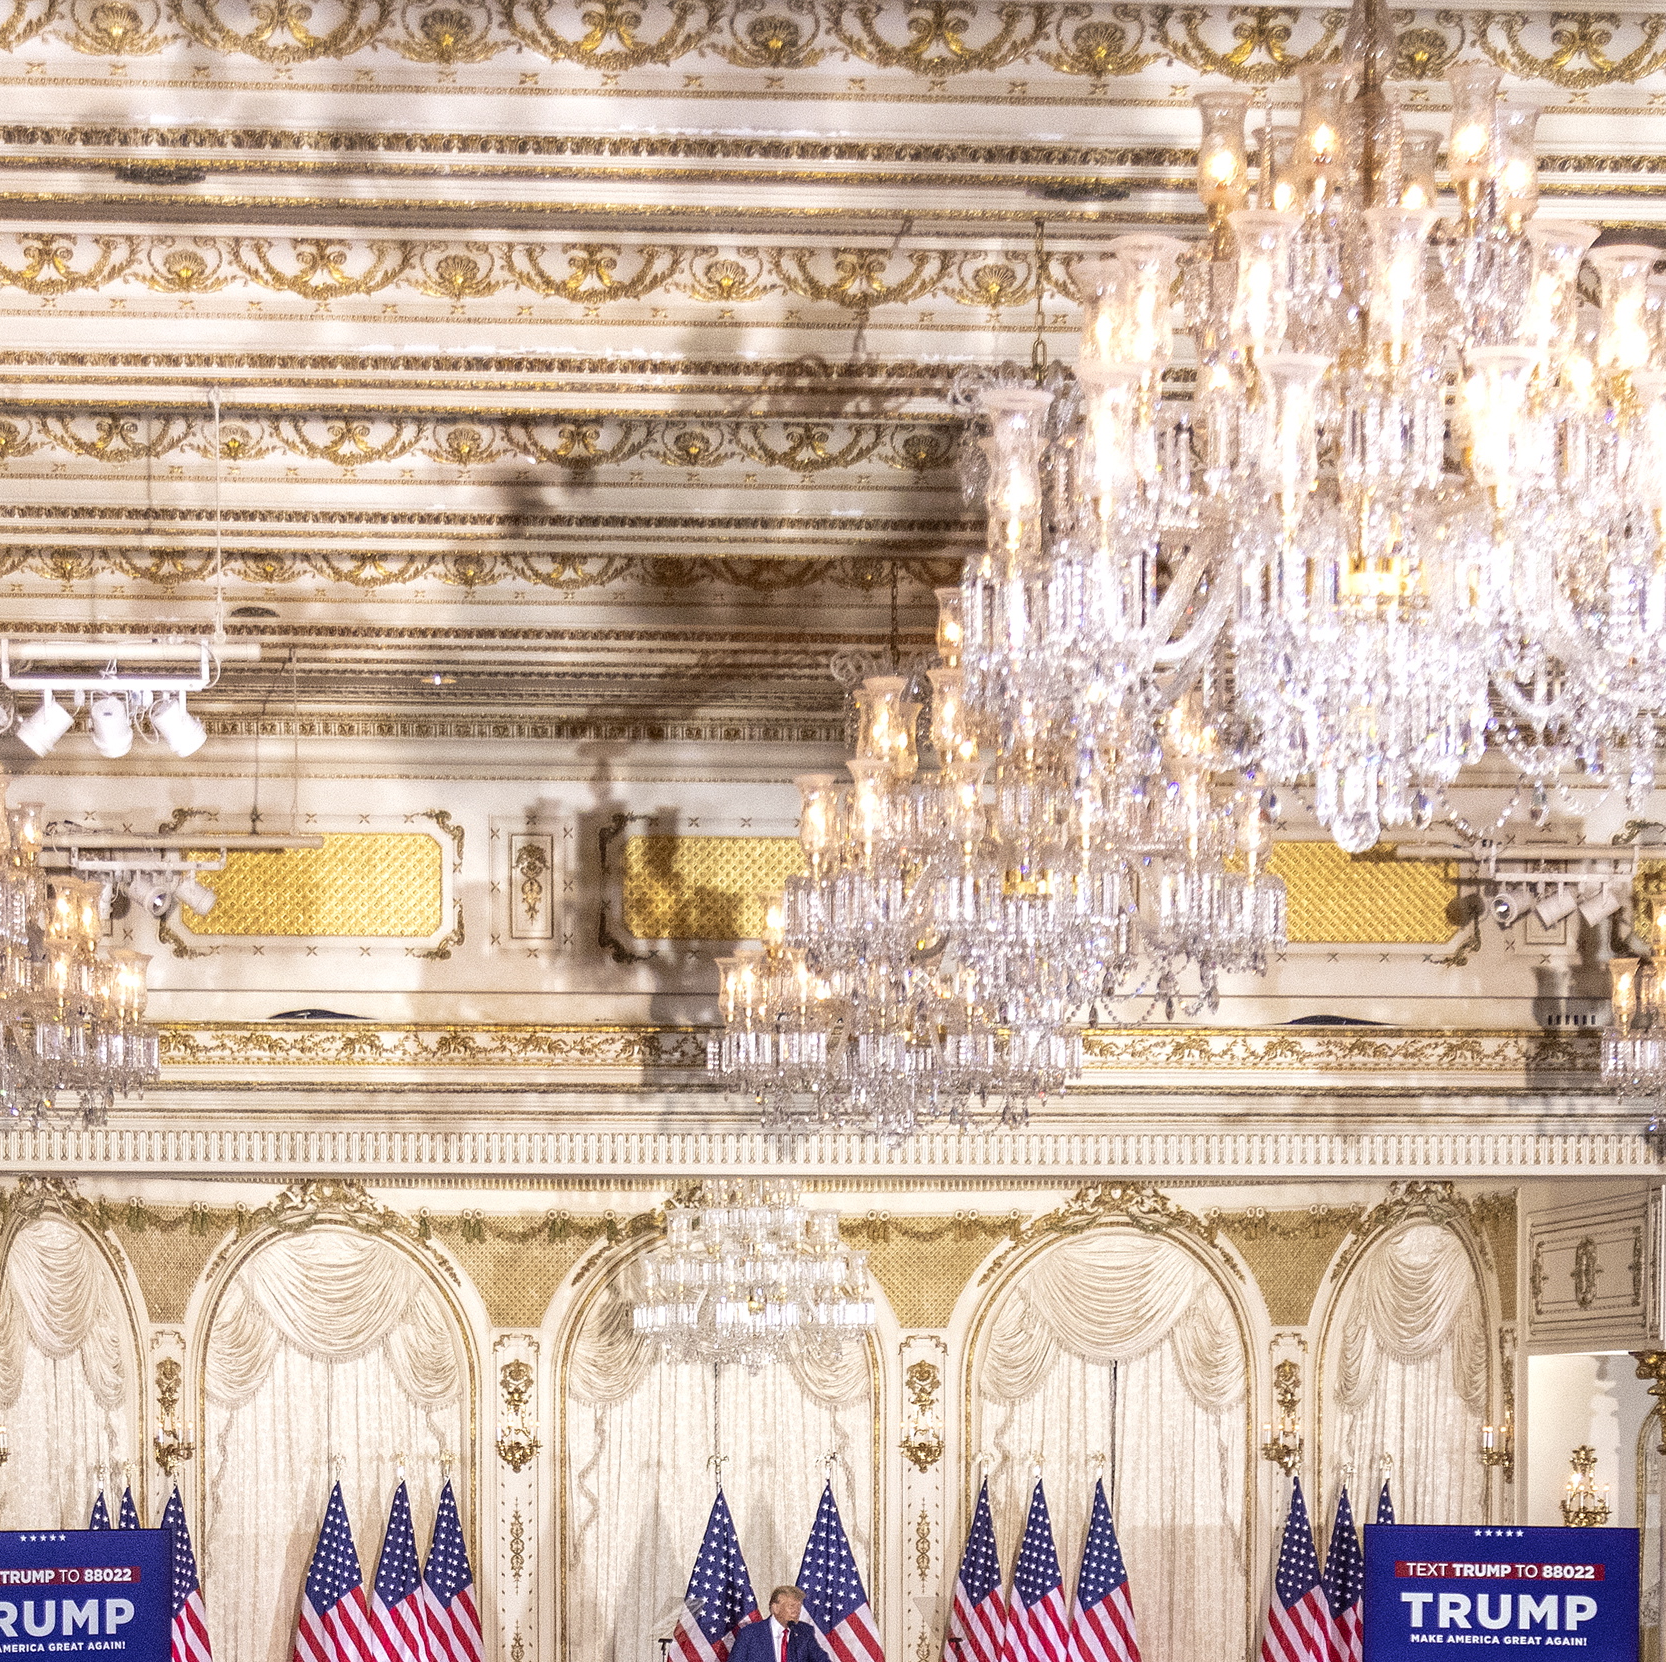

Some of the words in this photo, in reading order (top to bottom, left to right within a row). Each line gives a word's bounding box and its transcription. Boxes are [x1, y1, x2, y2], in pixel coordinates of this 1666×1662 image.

[0, 1569, 55, 1584] TRUMP
[59, 1569, 80, 1583] TO
[84, 1568, 132, 1582] 88022
[1407, 1562, 1448, 1577] TEXT
[1452, 1563, 1511, 1577] TRUMP
[1515, 1564, 1538, 1578] TO
[1542, 1565, 1595, 1579] 88022
[1400, 1592, 1598, 1631] TRUMP
[48, 1642, 84, 1652] GREAT
[88, 1641, 126, 1651] AGAIN!
[1411, 1633, 1444, 1644] MAKE
[1447, 1635, 1500, 1645] AMERICA
[1504, 1636, 1542, 1646] GREAT
[1545, 1636, 1587, 1646] AGAIN!
